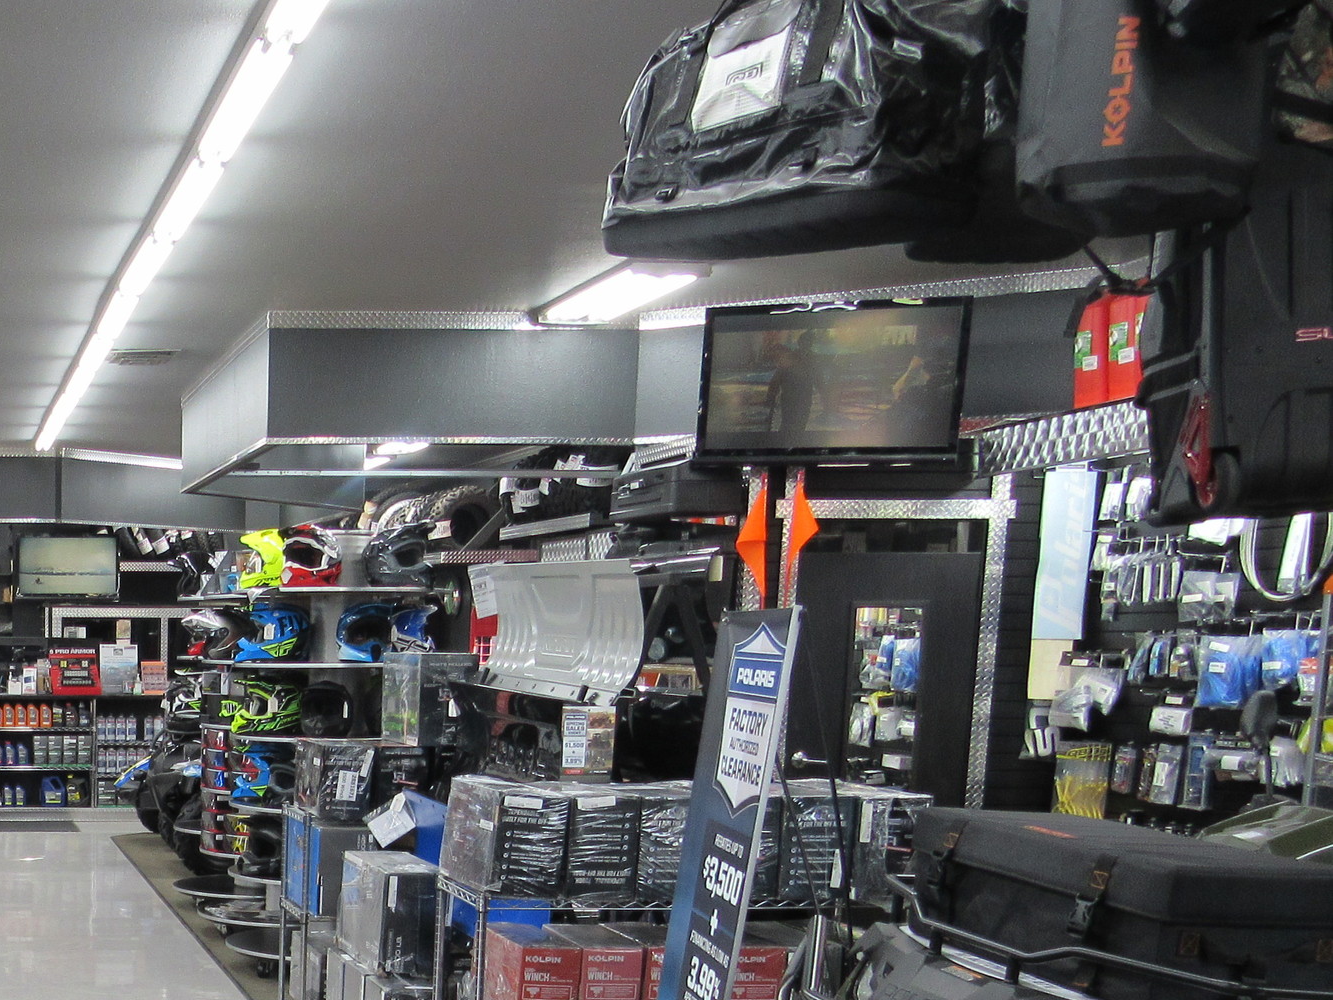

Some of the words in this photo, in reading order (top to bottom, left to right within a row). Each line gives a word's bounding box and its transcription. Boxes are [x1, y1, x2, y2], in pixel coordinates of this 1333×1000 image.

[1101, 15, 1141, 147] KOLPIN
[737, 667, 777, 688] POLARIS
[728, 707, 769, 737] FACTORY
[728, 737, 760, 756] AUTHORIZED
[720, 755, 762, 786] CLEARANCE
[714, 833, 731, 853] REBATES
[525, 955, 562, 964] KOLPIN
[524, 971, 550, 982] WINCH
[587, 971, 613, 981] WINCH
